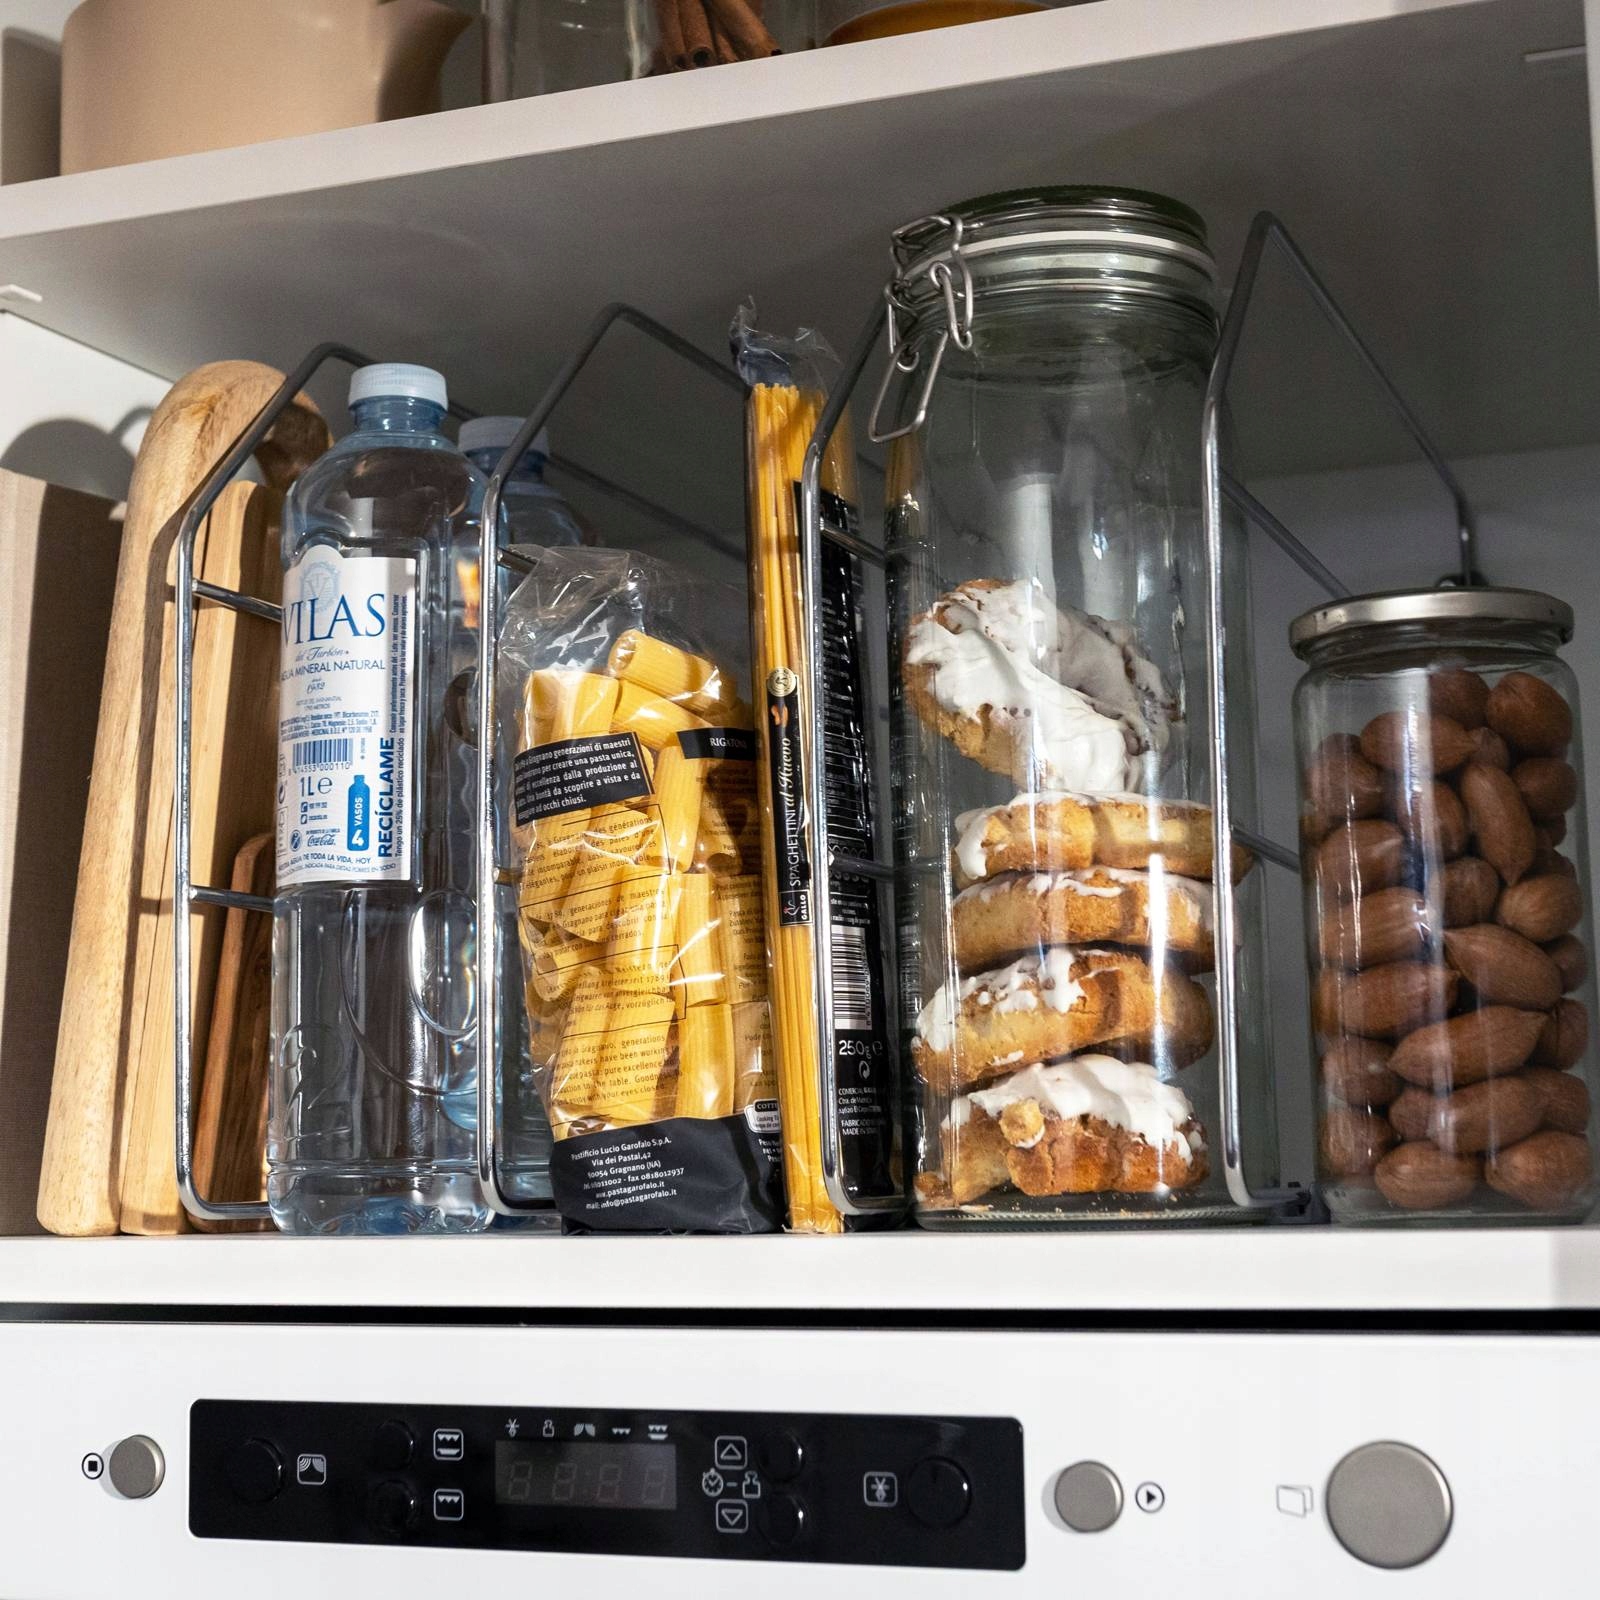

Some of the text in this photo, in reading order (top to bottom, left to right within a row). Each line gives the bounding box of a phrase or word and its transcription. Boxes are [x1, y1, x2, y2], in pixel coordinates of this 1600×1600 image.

[282, 593, 386, 648] VILAS
[295, 661, 331, 677] MINERAL
[333, 659, 386, 672] NATURAL
[553, 743, 593, 759] generazioni
[594, 743, 602, 751] di
[603, 738, 631, 750] maestri
[552, 760, 572, 770] creare
[574, 757, 588, 765] una
[589, 753, 610, 764] pasta
[611, 749, 634, 759] unica,
[563, 770, 582, 780] dalla
[585, 763, 626, 777] produzione
[630, 760, 638, 768] al
[396, 770, 404, 797] plástico
[553, 787, 561, 796] da
[564, 780, 594, 794] scoprire
[603, 775, 621, 784] vista
[631, 771, 640, 780] da
[375, 737, 394, 857] RECÍCLAME
[396, 799, 403, 808] de
[543, 801, 560, 811] occhi
[561, 794, 586, 807] chiusi.
[354, 796, 363, 827] VASOS
[396, 826, 402, 834] un
[609, 816, 652, 833] générations
[351, 829, 364, 848] 4
[395, 836, 403, 857] Tengo
[784, 807, 801, 887] SPAGHETTINI
[355, 856, 371, 864] HOY
[587, 864, 608, 875] plaisir
[799, 894, 808, 920] GALLO
[621, 1034, 665, 1048] generations
[838, 1040, 872, 1059] 250g
[600, 1053, 618, 1063] have
[620, 1051, 638, 1060] been
[604, 1065, 621, 1076] pure
[623, 1060, 662, 1072] excellence
[609, 1076, 631, 1087] table.
[621, 1087, 638, 1098] eyes
[571, 1136, 672, 1161] Pastificio Lucio Garofalo S.p.A.
[592, 1156, 604, 1167] Via
[605, 1156, 617, 1165] dei
[610, 1163, 645, 1175] Gragnano
[646, 1160, 661, 1170] (NA)
[627, 1173, 640, 1182] fax
[641, 1167, 684, 1181] 0818012937
[601, 1189, 677, 1209] info@pastagarofalo.it
